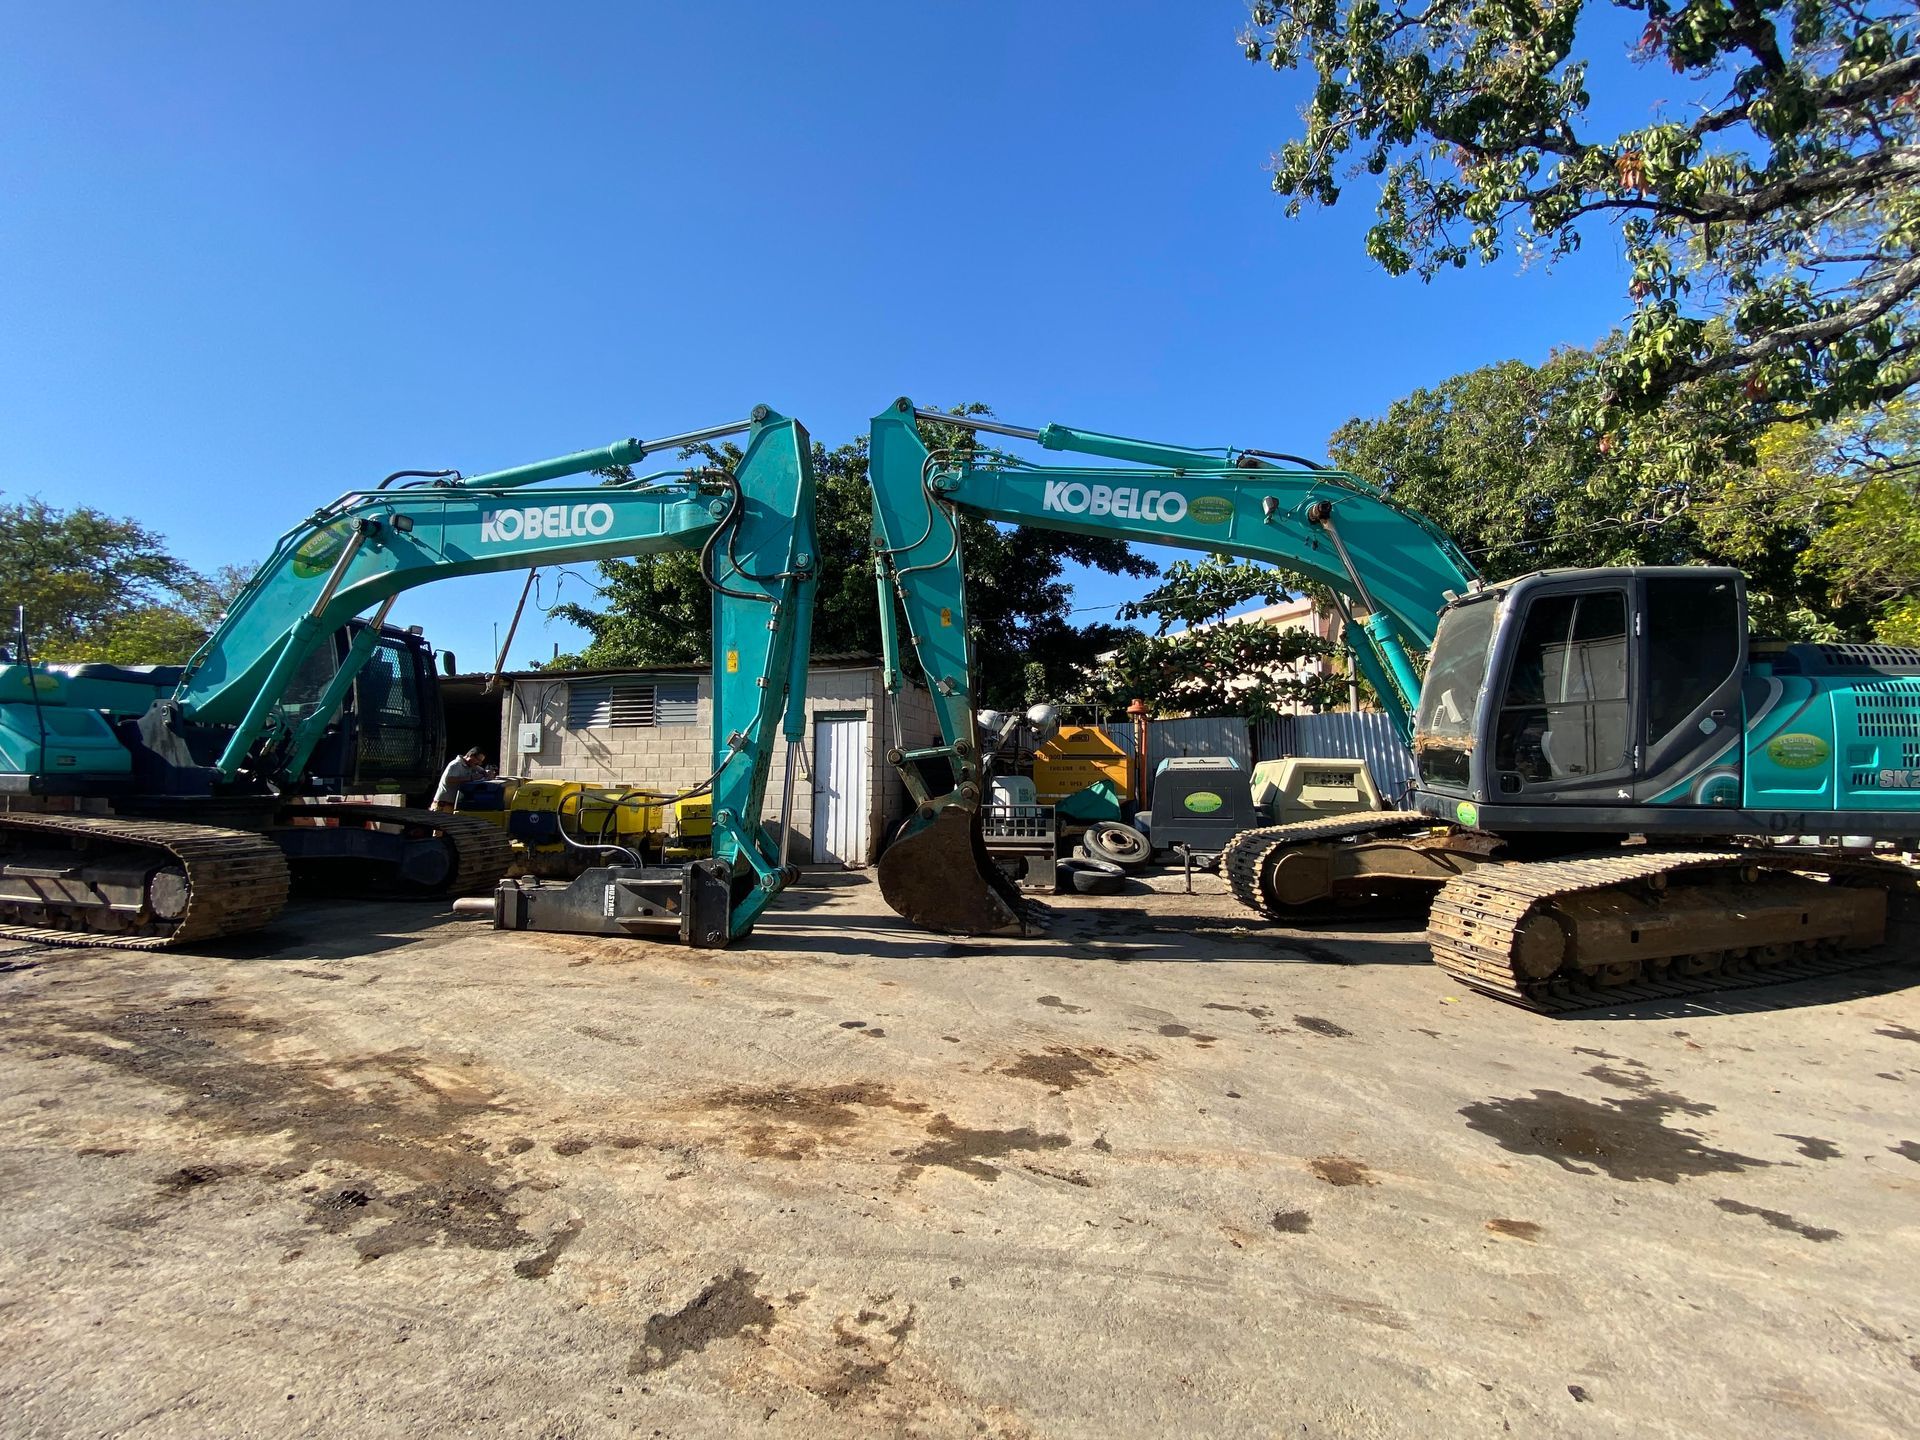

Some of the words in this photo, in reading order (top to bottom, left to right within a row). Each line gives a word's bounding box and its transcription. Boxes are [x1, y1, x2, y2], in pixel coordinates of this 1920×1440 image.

[1043, 480, 1187, 523] KOBELCO
[481, 503, 614, 542] KOBELCO
[1879, 769, 1920, 788] SK2
[607, 884, 615, 917] MUSTANG
